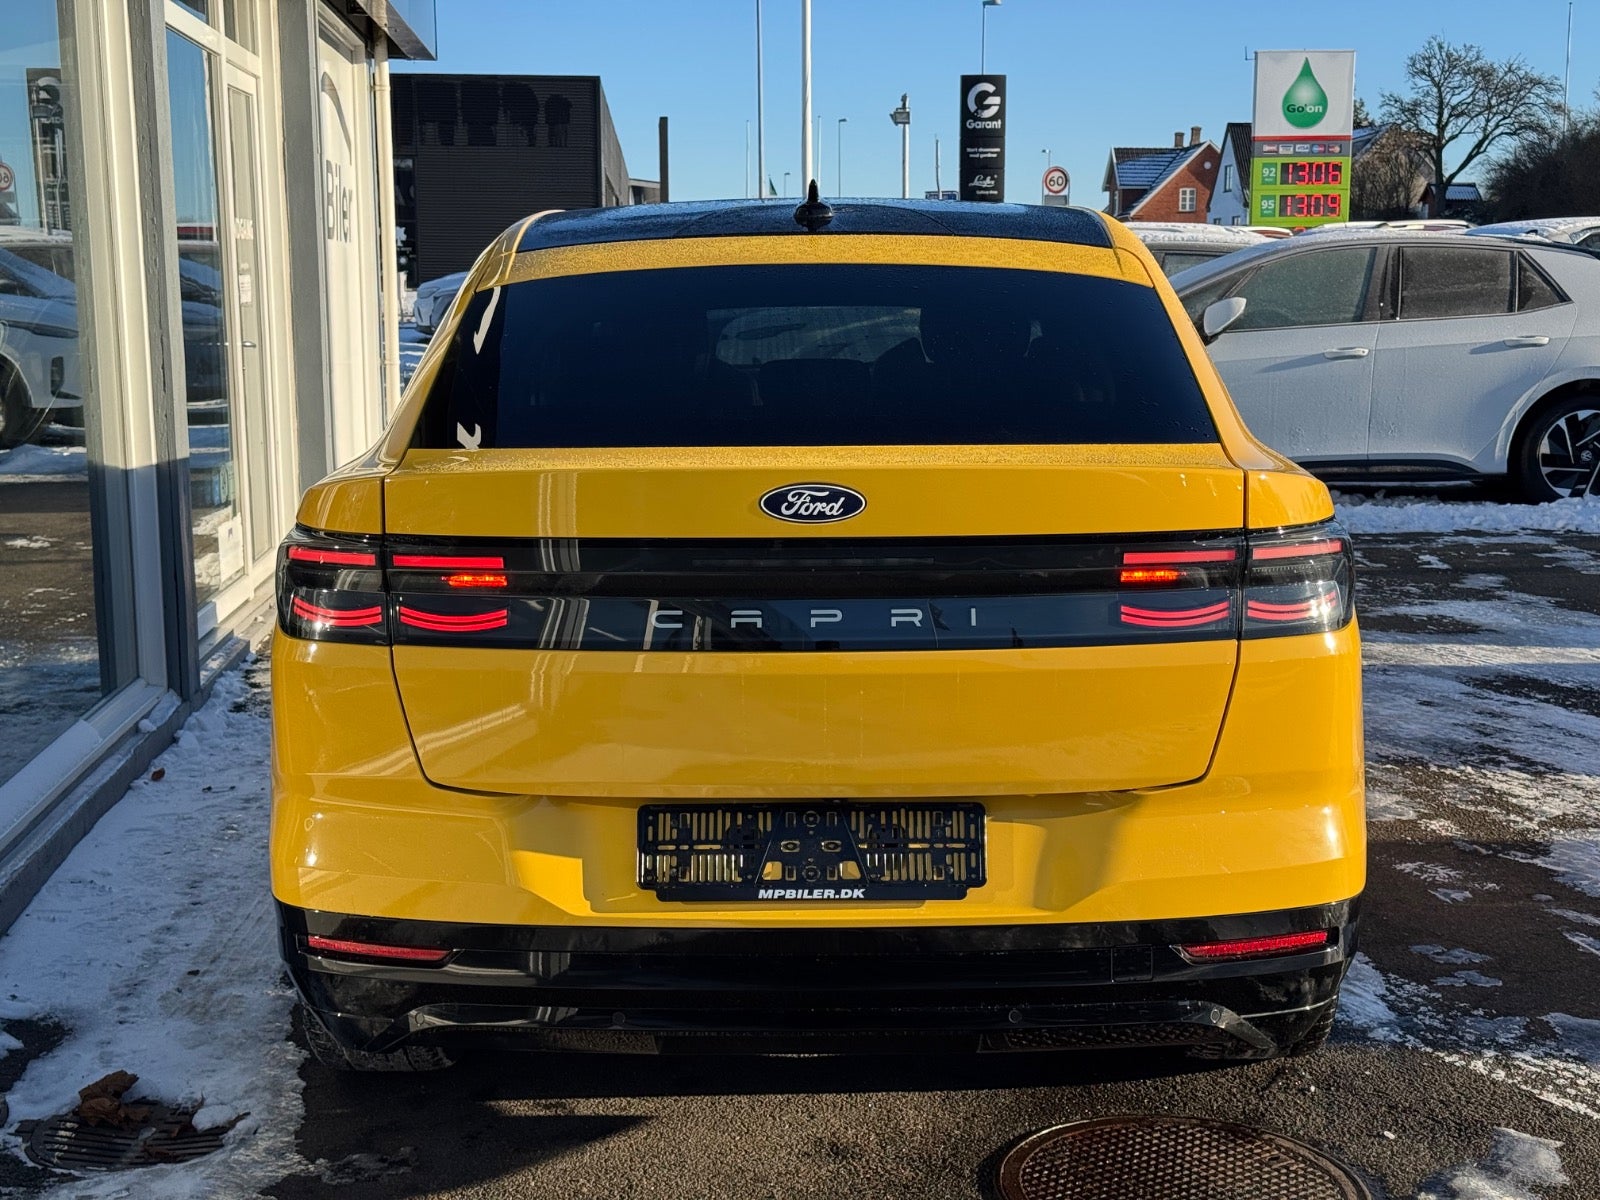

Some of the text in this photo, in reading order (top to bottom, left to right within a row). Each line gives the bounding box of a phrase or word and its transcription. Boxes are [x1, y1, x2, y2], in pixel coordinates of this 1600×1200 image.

[966, 120, 1001, 129] Garant
[1048, 176, 1064, 187] 60
[1262, 162, 1342, 185] 92 13.06
[326, 160, 353, 244] Biler
[1261, 194, 1341, 217] 95 13.09
[781, 489, 846, 516] Ford
[650, 607, 977, 629] CAPRI
[758, 888, 865, 899] MPBILER.DK
